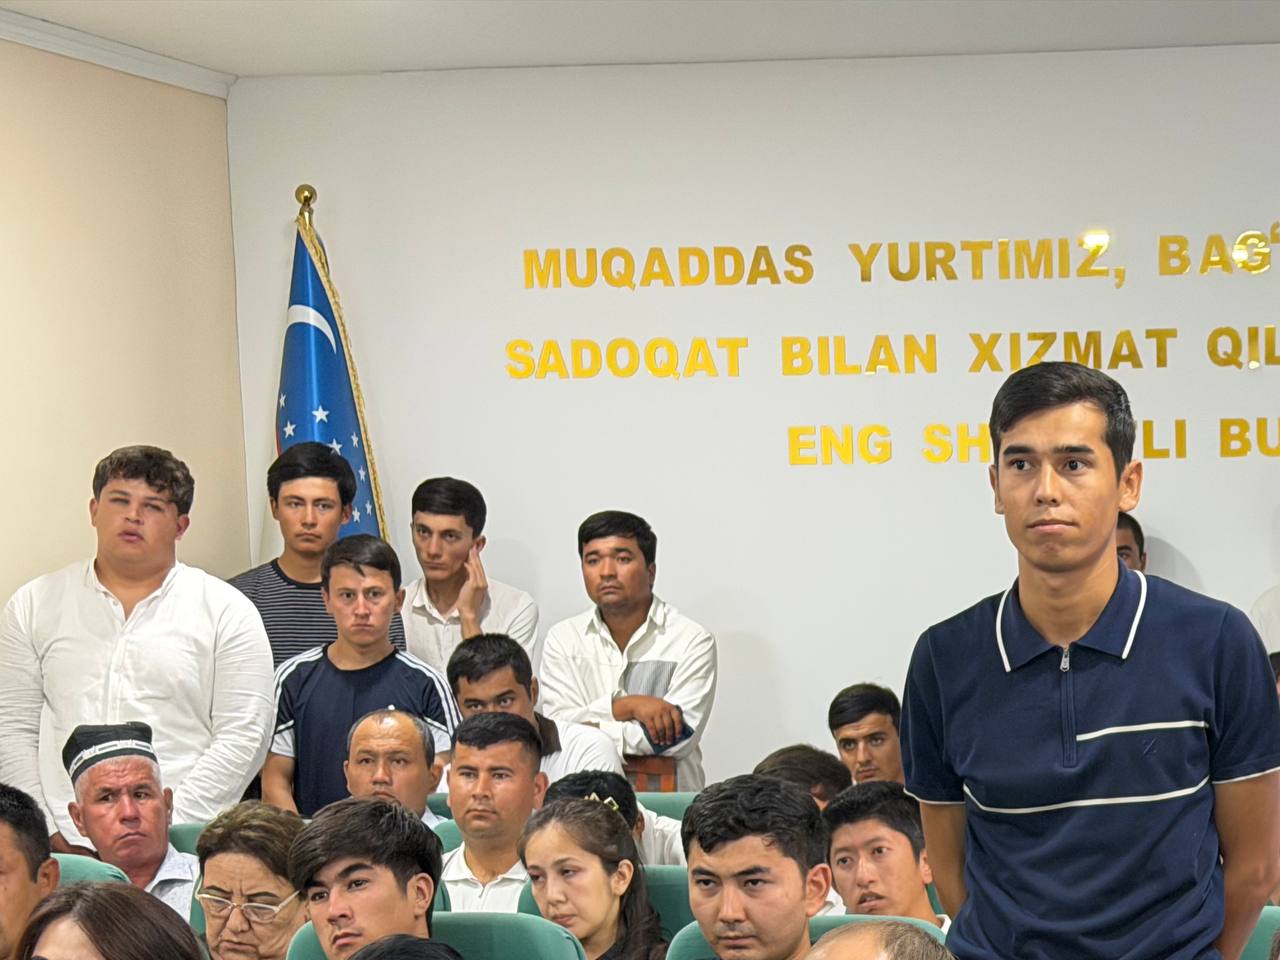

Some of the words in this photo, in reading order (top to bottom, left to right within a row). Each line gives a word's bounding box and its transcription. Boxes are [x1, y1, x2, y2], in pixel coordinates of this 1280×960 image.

[522, 244, 814, 290] MUQADDAS
[848, 232, 1127, 288] YURTIMIZ,
[505, 336, 749, 379] SADOQAT
[781, 334, 938, 376] BILAN
[969, 328, 1178, 374] XIZMAT
[787, 423, 893, 466] ENG
